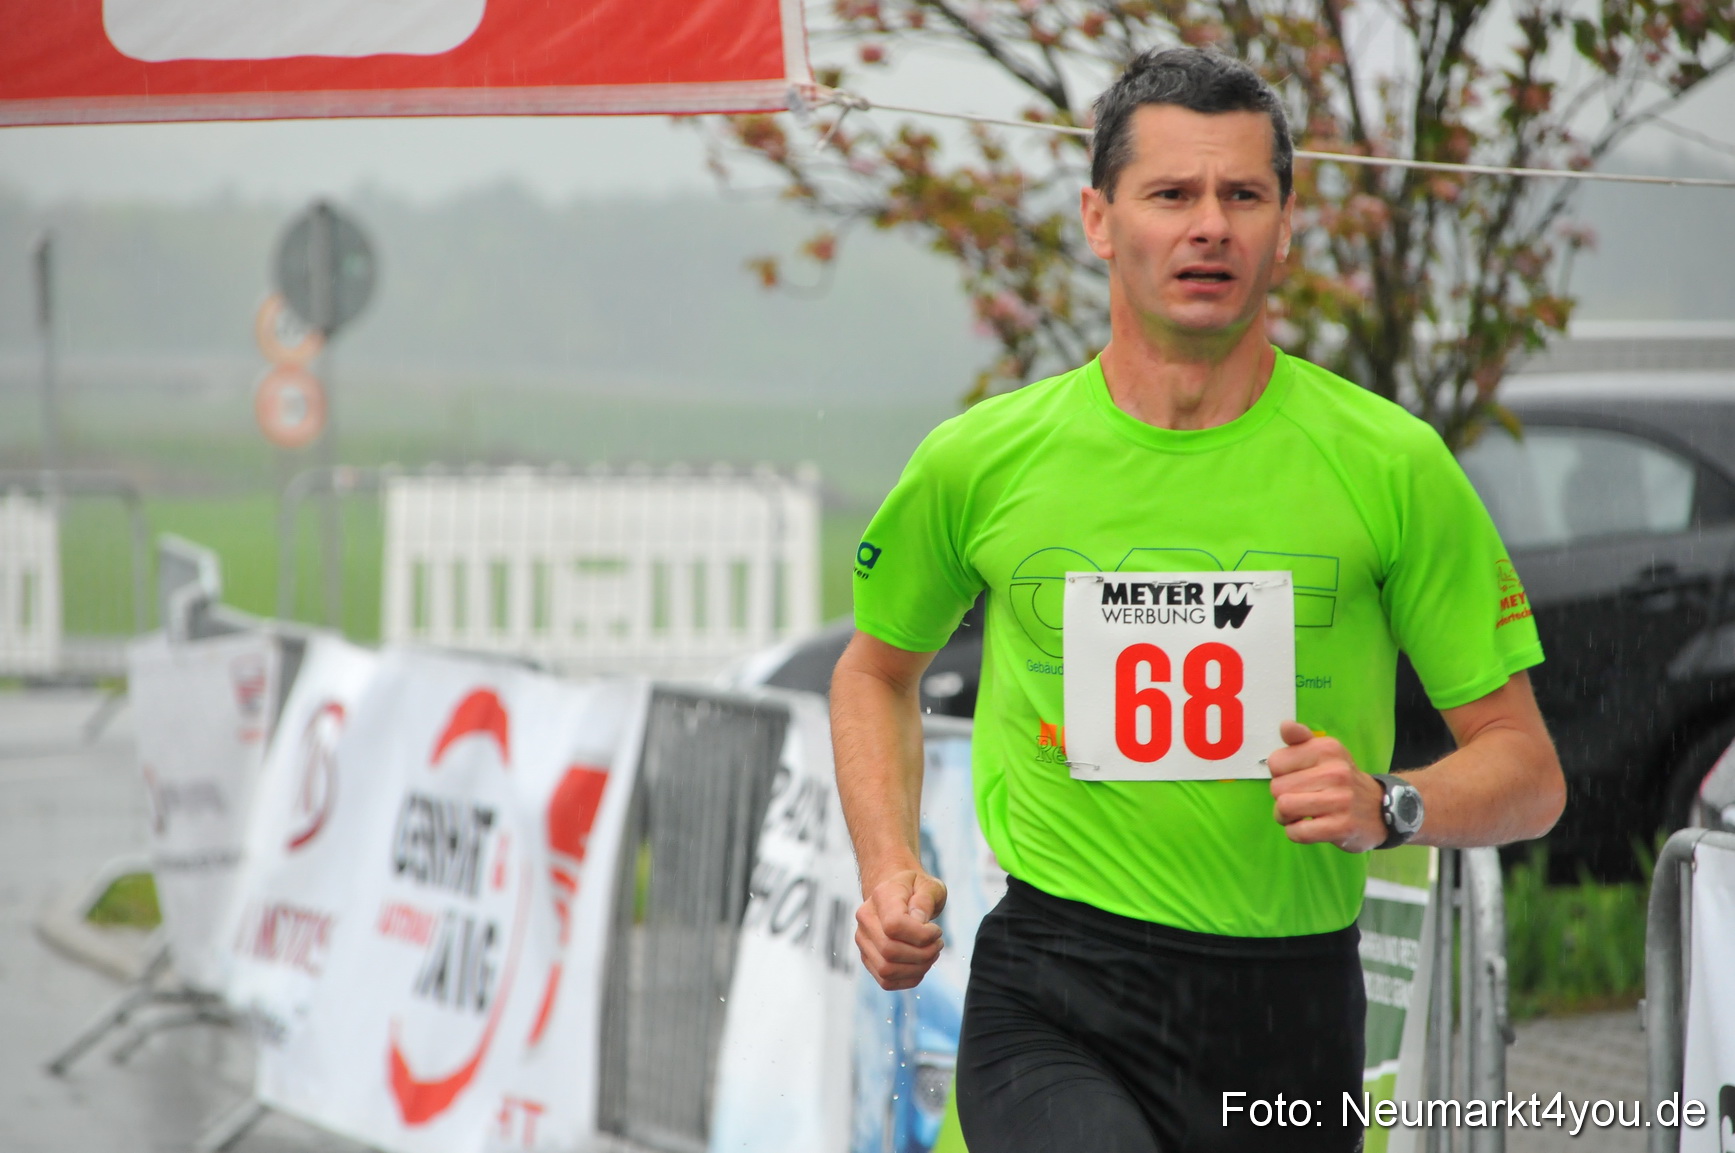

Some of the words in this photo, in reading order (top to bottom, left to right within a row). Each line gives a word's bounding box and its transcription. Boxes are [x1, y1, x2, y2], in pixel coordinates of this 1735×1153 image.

[1101, 582, 1205, 606] MEYER
[1101, 607, 1206, 625] WERBUNG
[1295, 674, 1333, 689] GmbH
[1115, 642, 1244, 763] 68
